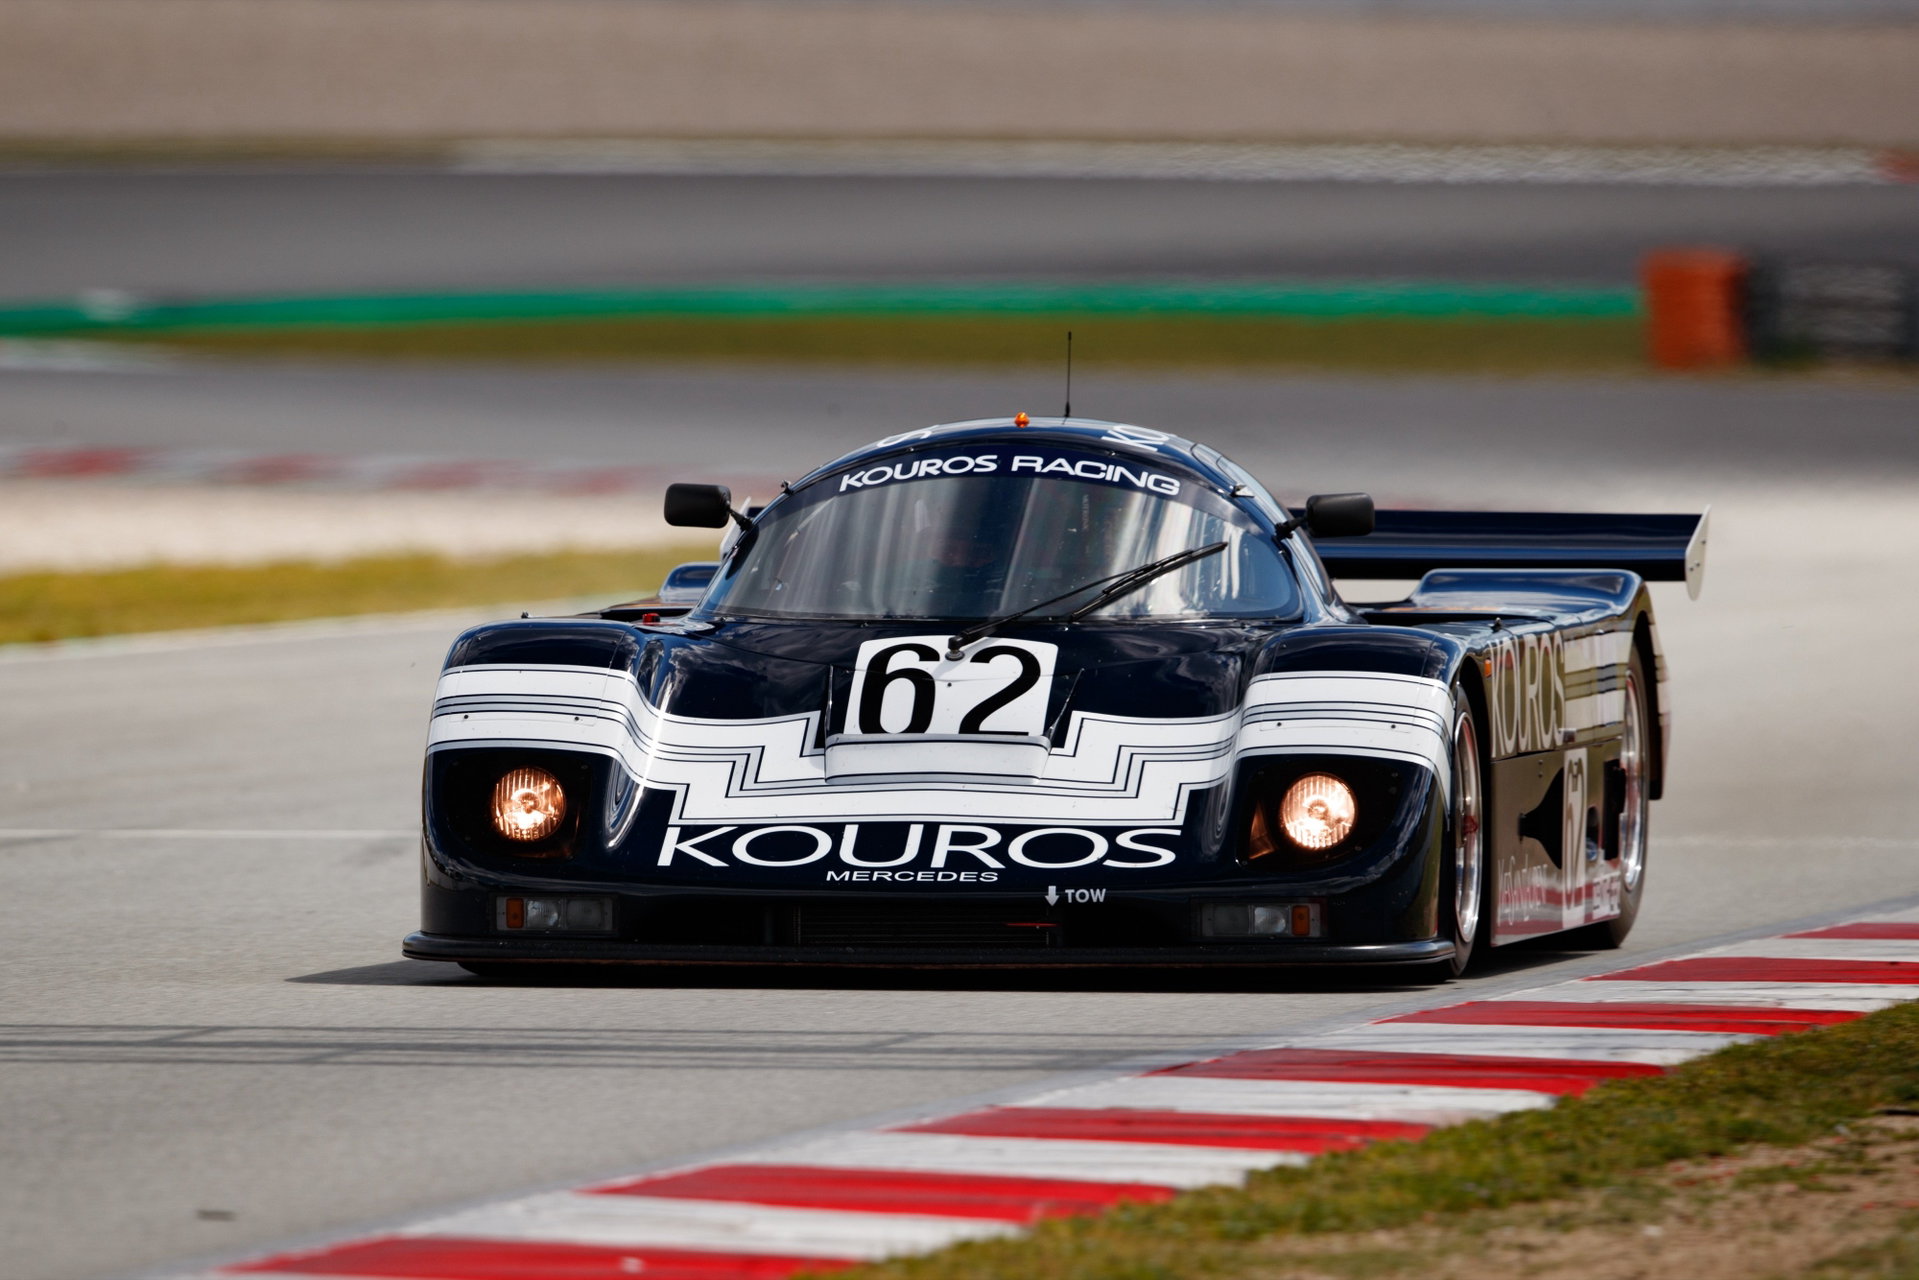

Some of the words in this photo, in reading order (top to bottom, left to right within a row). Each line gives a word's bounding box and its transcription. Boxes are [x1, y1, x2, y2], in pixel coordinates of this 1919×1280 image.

[839, 454, 998, 493] KOUROS
[1011, 455, 1182, 496] RACING
[858, 643, 1042, 736] 62
[1488, 631, 1566, 759] KOUROS
[657, 824, 1184, 869] KOUROS
[826, 870, 999, 883] MERCEDES
[1064, 888, 1107, 903] TOW
